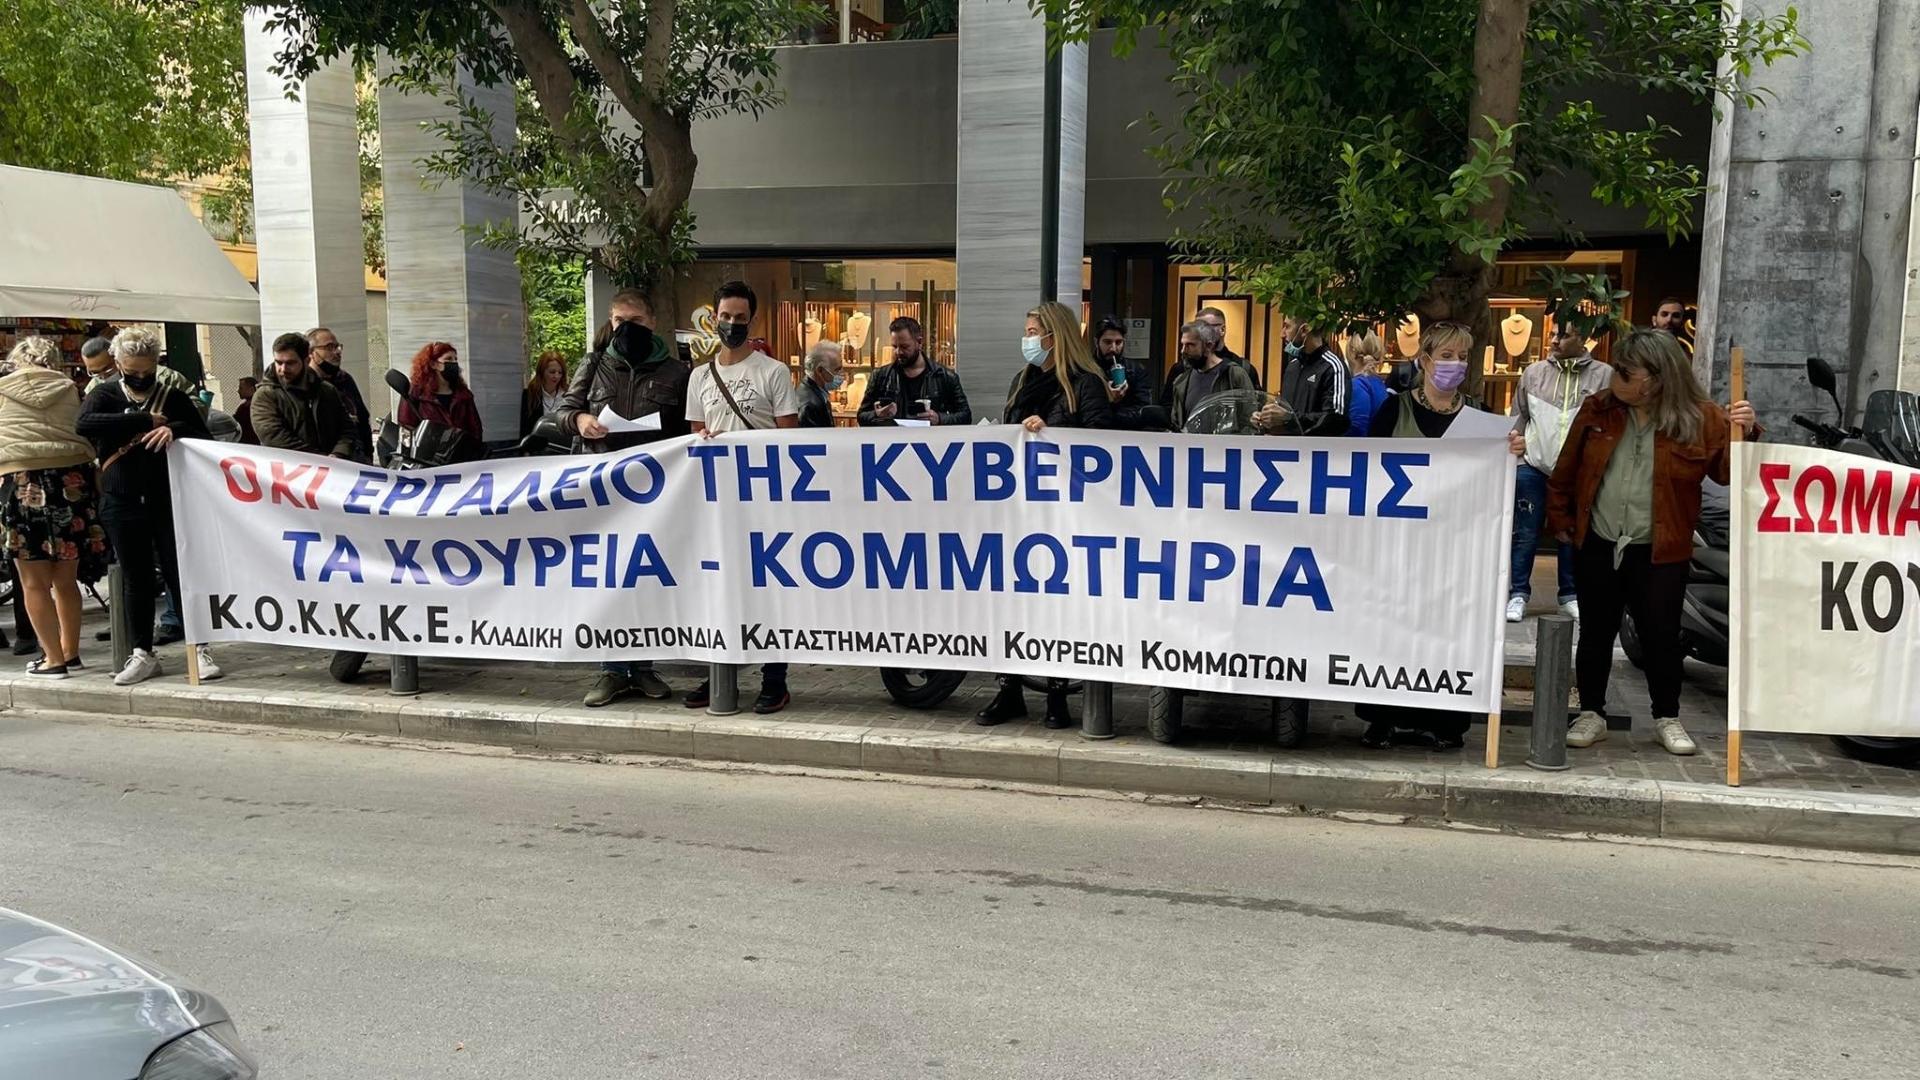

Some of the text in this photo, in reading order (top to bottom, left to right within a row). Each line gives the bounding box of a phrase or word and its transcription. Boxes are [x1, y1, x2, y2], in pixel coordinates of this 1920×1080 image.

[343, 453, 666, 517] ΕΡΓΑΛΕΙΟ
[688, 444, 831, 502] ΤΗΣ
[861, 441, 1430, 519] ΚΥΒΕΡΝΗΣΗΣ
[282, 531, 365, 584] ΤΑ
[750, 531, 1334, 612] ΚΟΜΜΩΤΗΡΙΑ
[208, 594, 464, 645] Κ.Ο.Κ.Κ.Κ.Ε.
